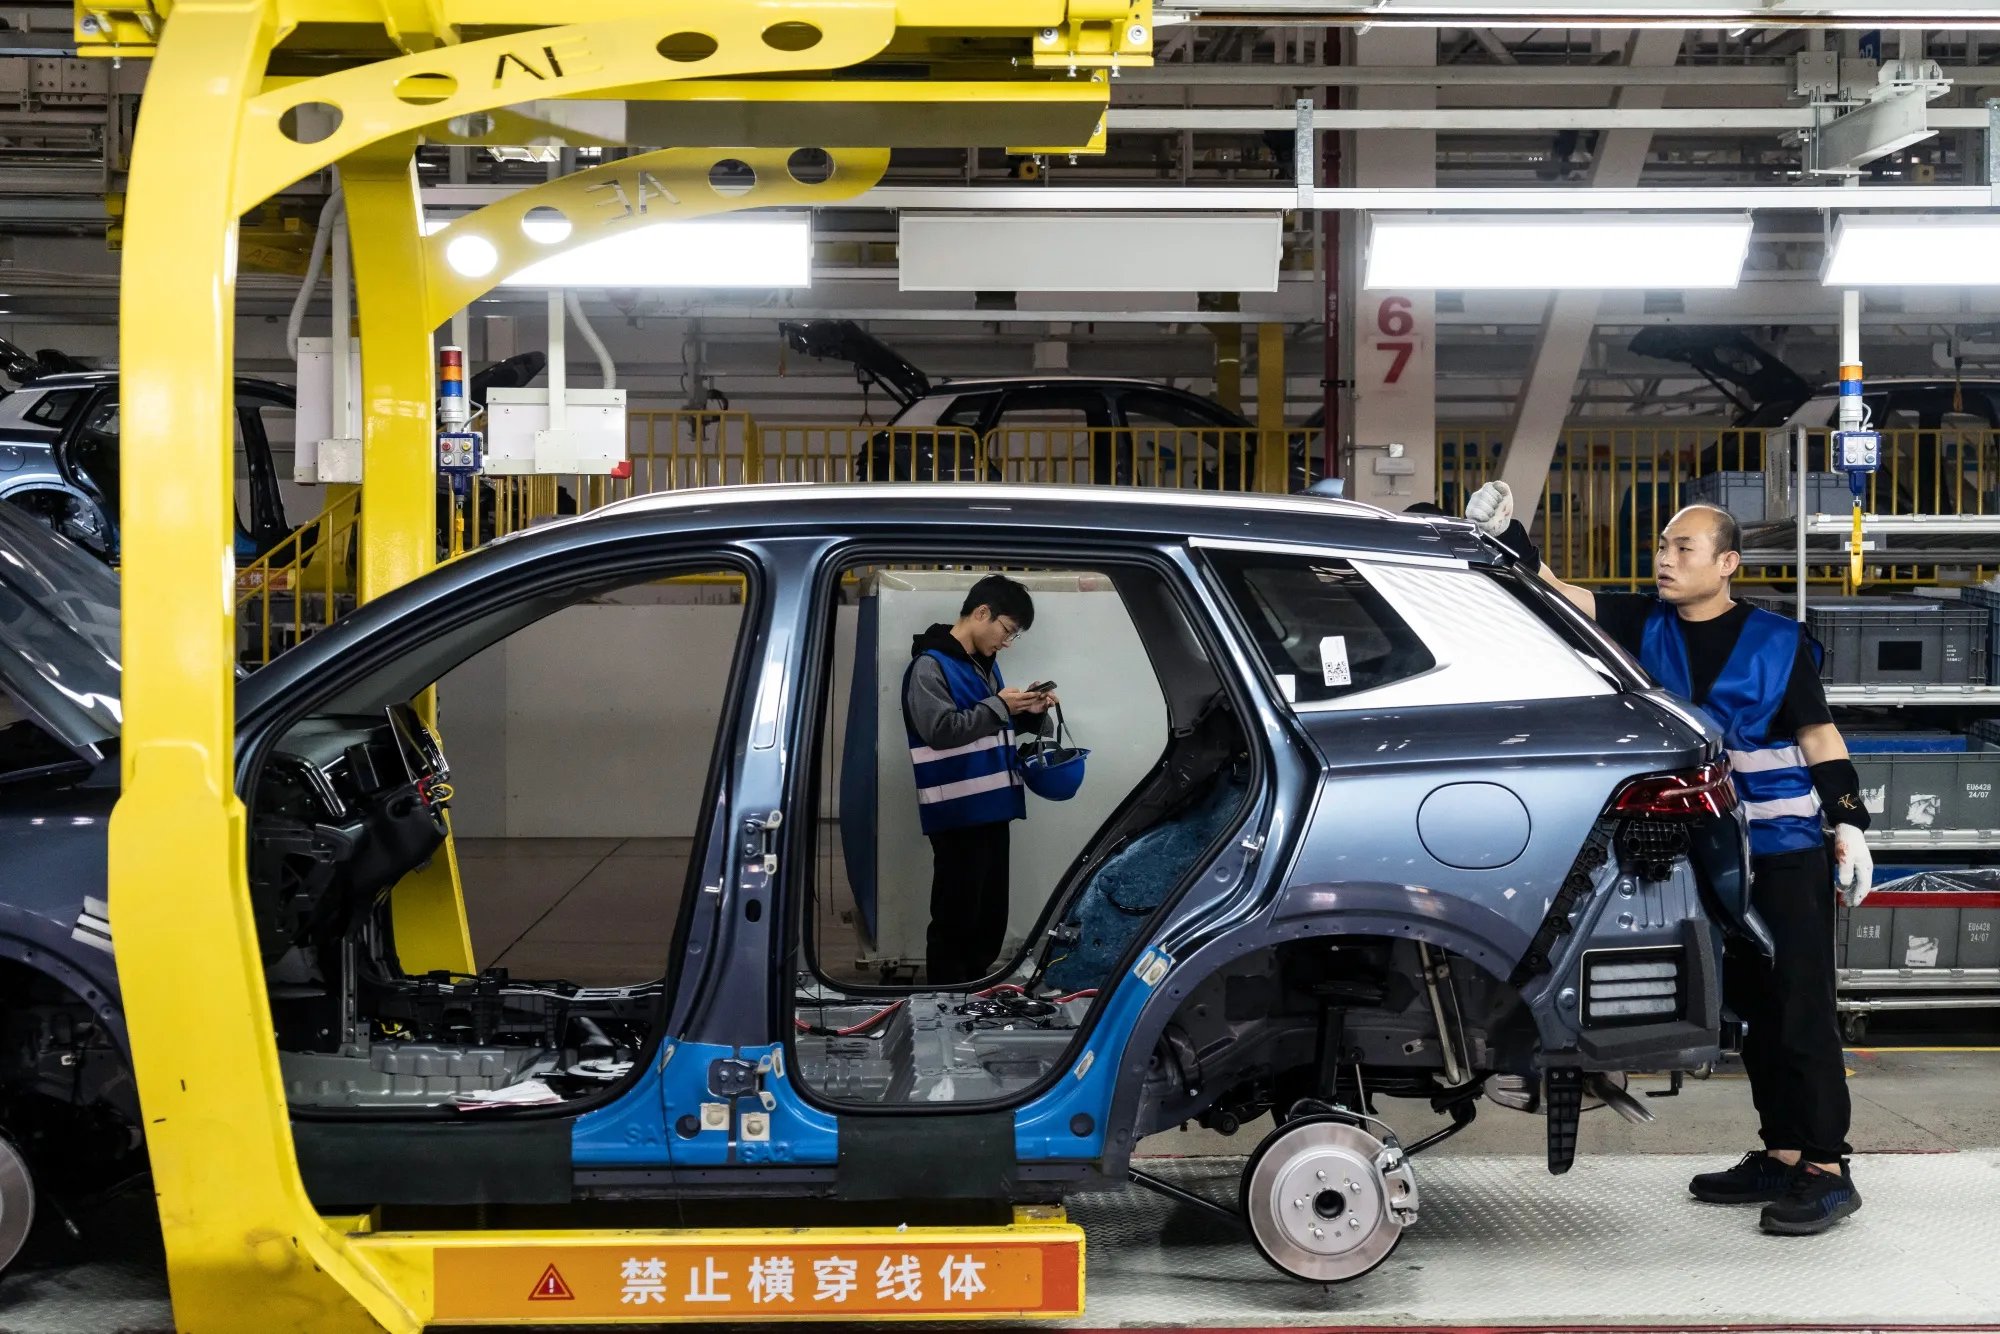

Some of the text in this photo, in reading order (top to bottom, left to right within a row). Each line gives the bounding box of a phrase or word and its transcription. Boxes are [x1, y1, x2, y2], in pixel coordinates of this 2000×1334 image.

[492, 36, 604, 89] AE
[1966, 783, 1992, 791] EU6428
[1968, 922, 1991, 932] EU6428
[1970, 933, 1989, 942] 24/07
[620, 1254, 987, 1305] 禁止横穿线体
